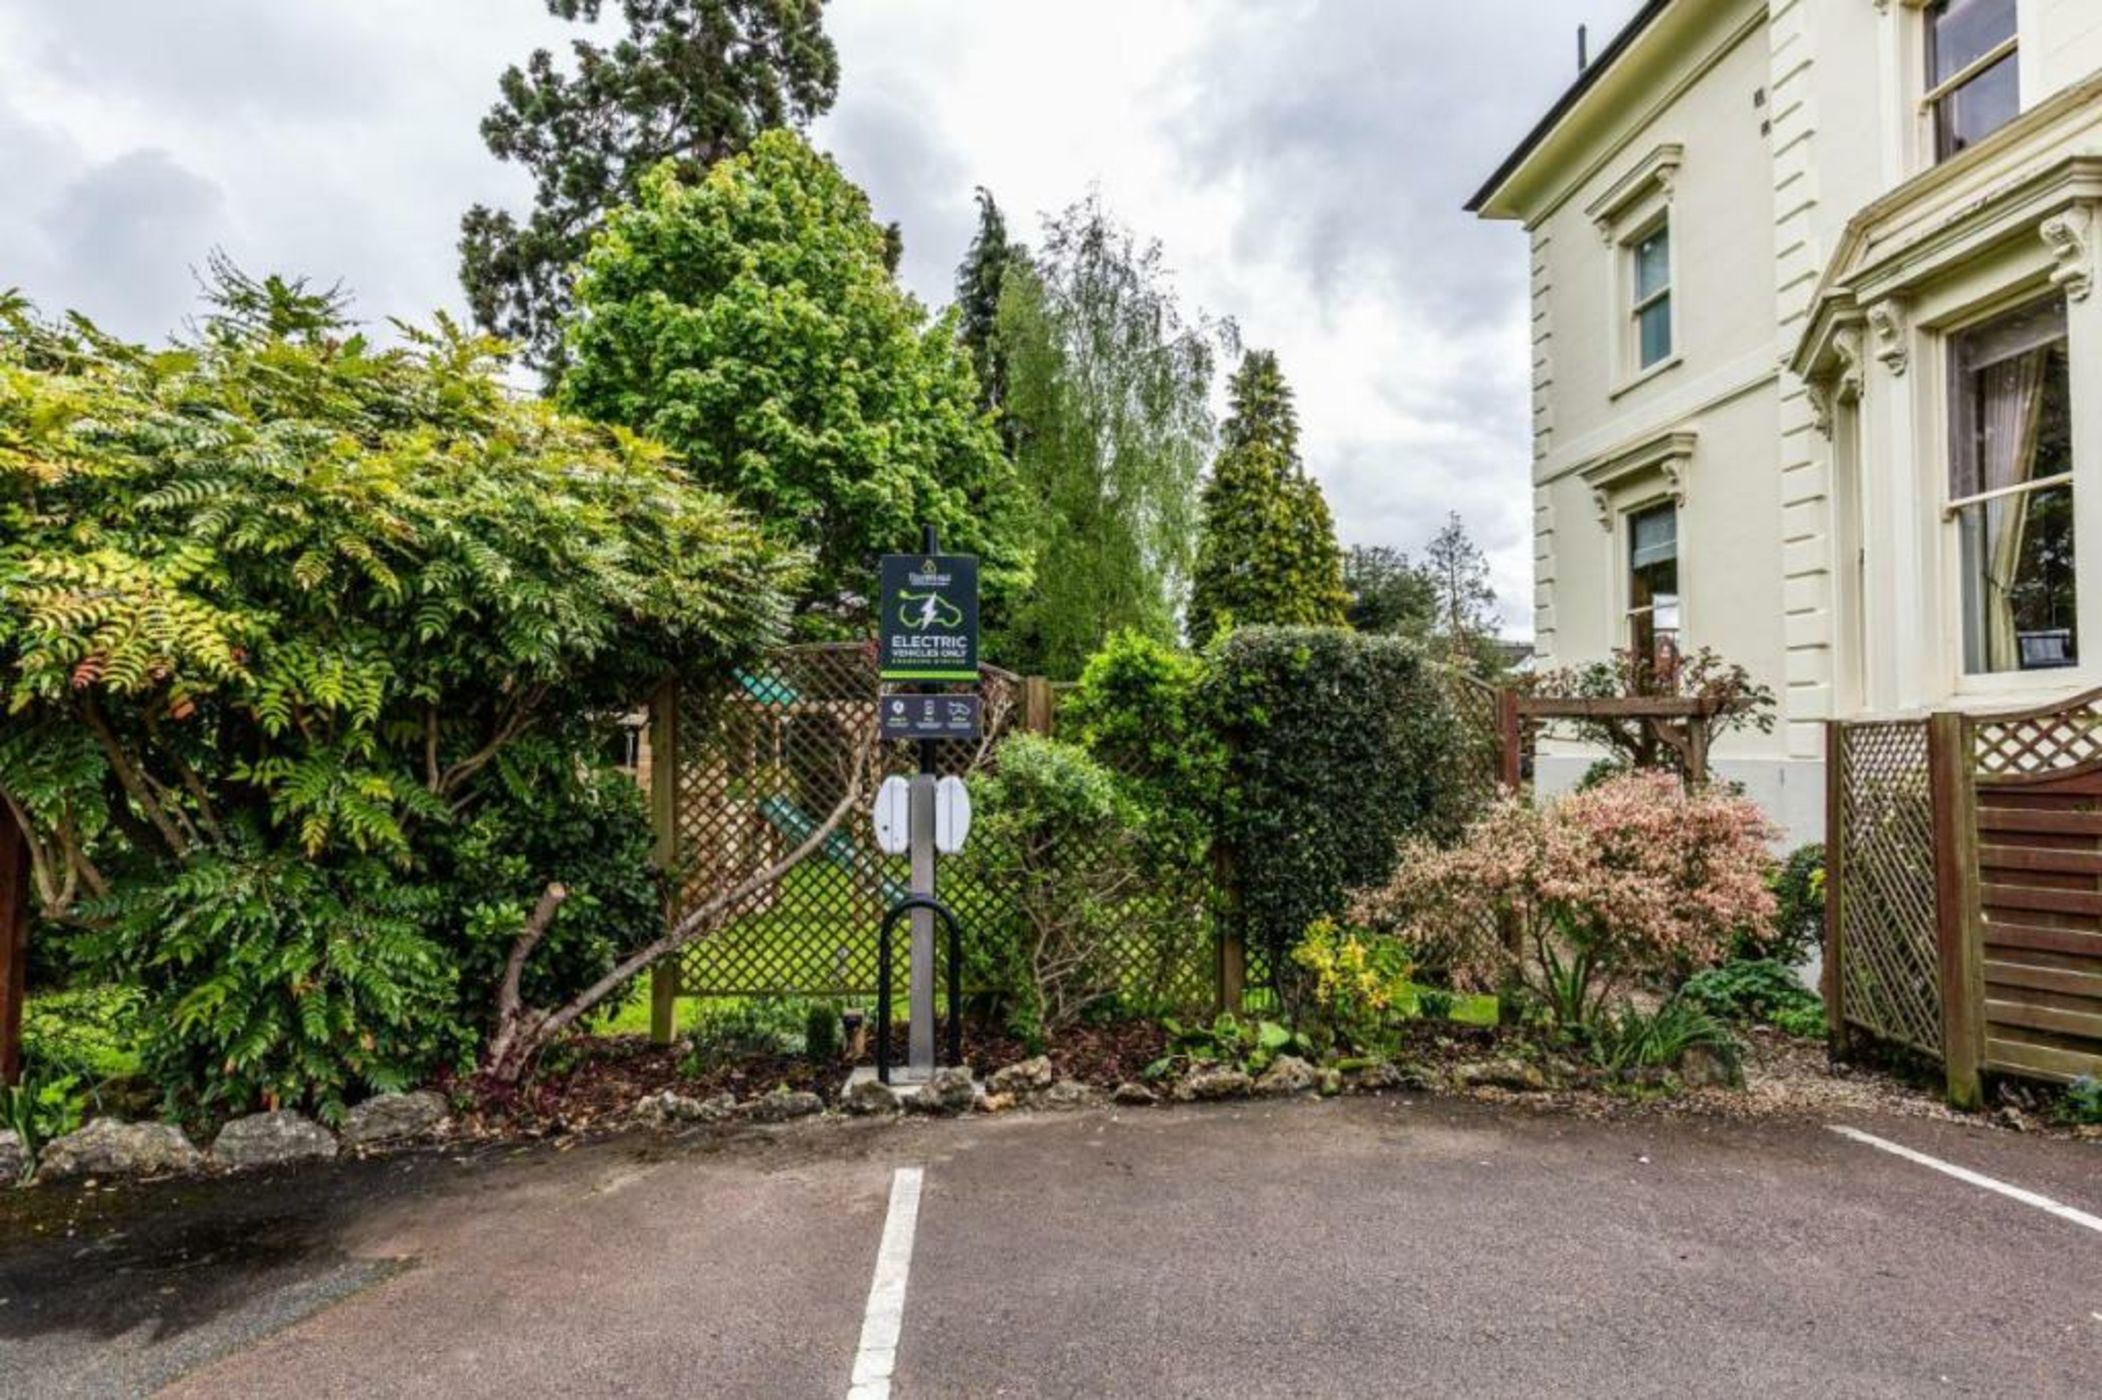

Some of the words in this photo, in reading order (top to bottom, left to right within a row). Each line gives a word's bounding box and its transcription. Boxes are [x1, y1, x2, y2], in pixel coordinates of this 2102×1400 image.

[892, 635, 968, 648] ELECTRIC
[892, 648, 939, 658] VEHICLES
[941, 648, 968, 658] ONLY
